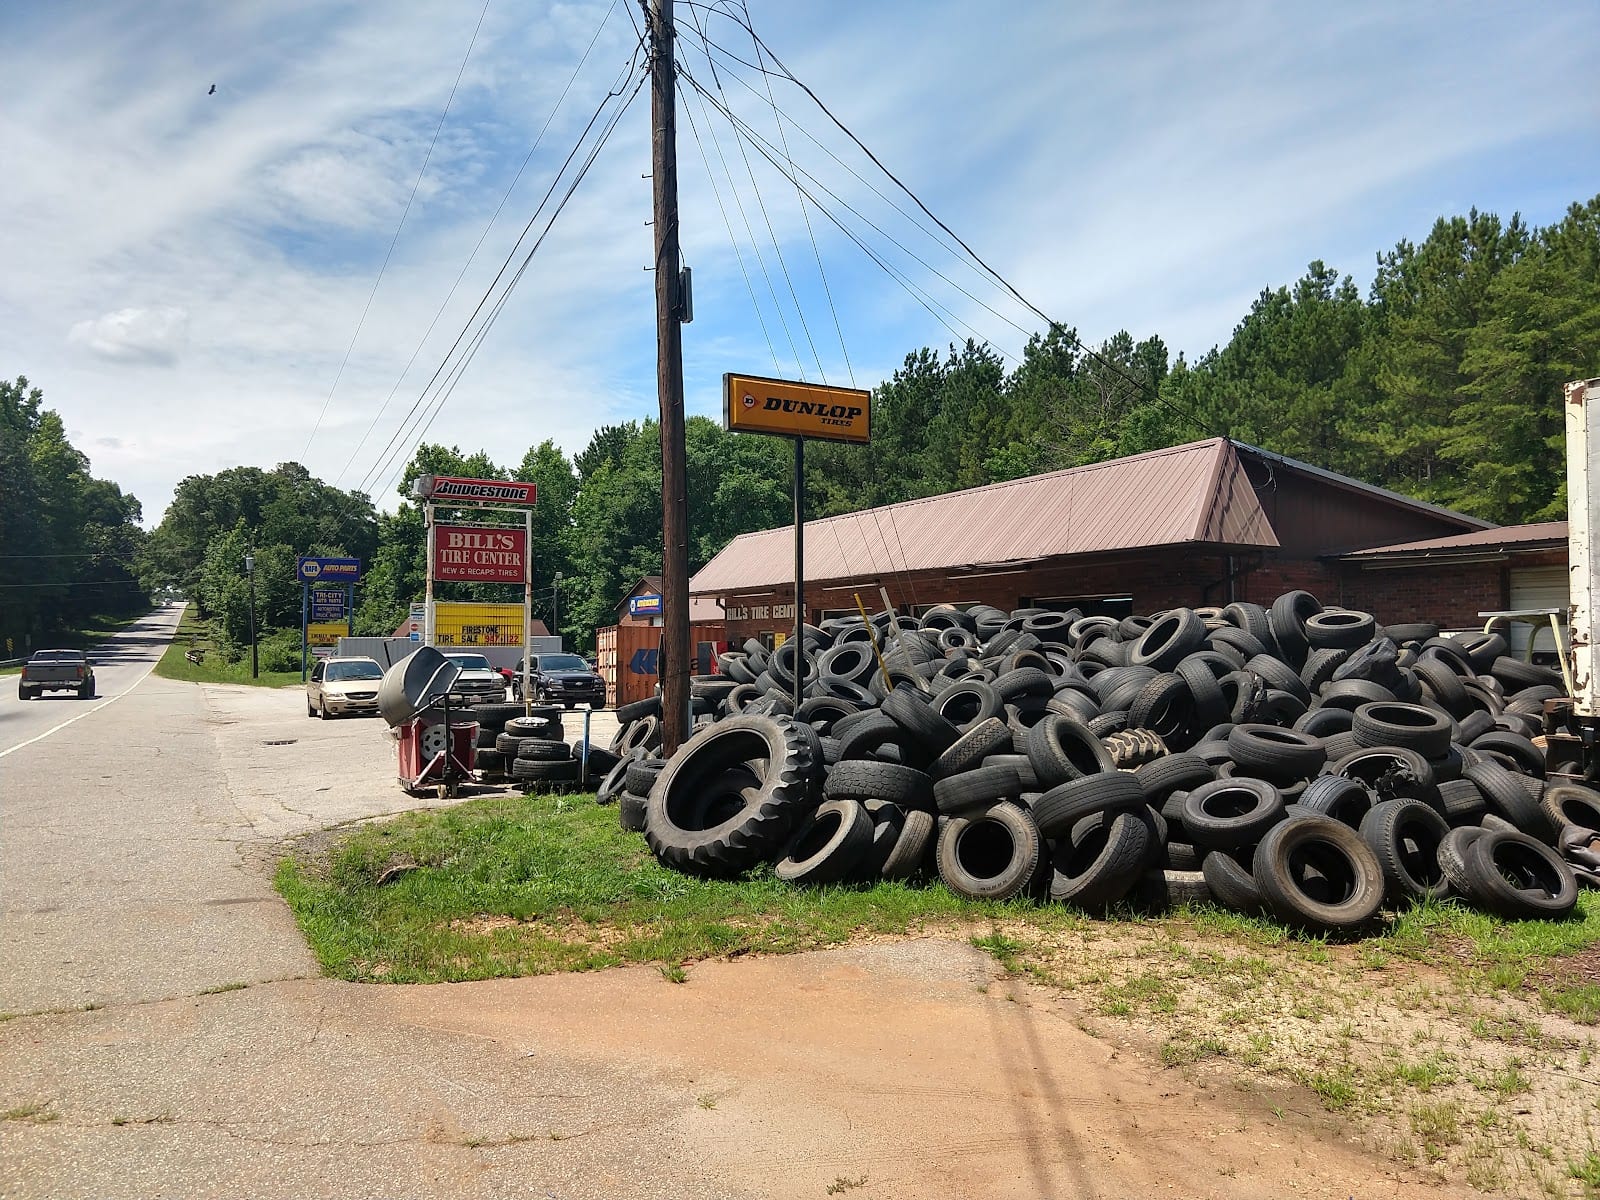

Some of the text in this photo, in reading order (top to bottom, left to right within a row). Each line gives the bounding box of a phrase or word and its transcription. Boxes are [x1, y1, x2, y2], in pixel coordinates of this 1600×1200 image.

[763, 397, 862, 419] DUNLOP
[821, 417, 852, 427] TIRES
[435, 480, 528, 500] BRIDGESTONE
[448, 532, 514, 550] BILL'S
[441, 549, 521, 566] TIRE CENTER
[323, 564, 339, 572] AUTO
[460, 567, 466, 575] &
[498, 569, 518, 577] TIRES
[727, 604, 748, 621] BILL'S
[751, 605, 770, 620] TIRE
[462, 625, 499, 634] FIRESTONE
[438, 634, 454, 643] TIRE
[461, 634, 478, 643] SALE
